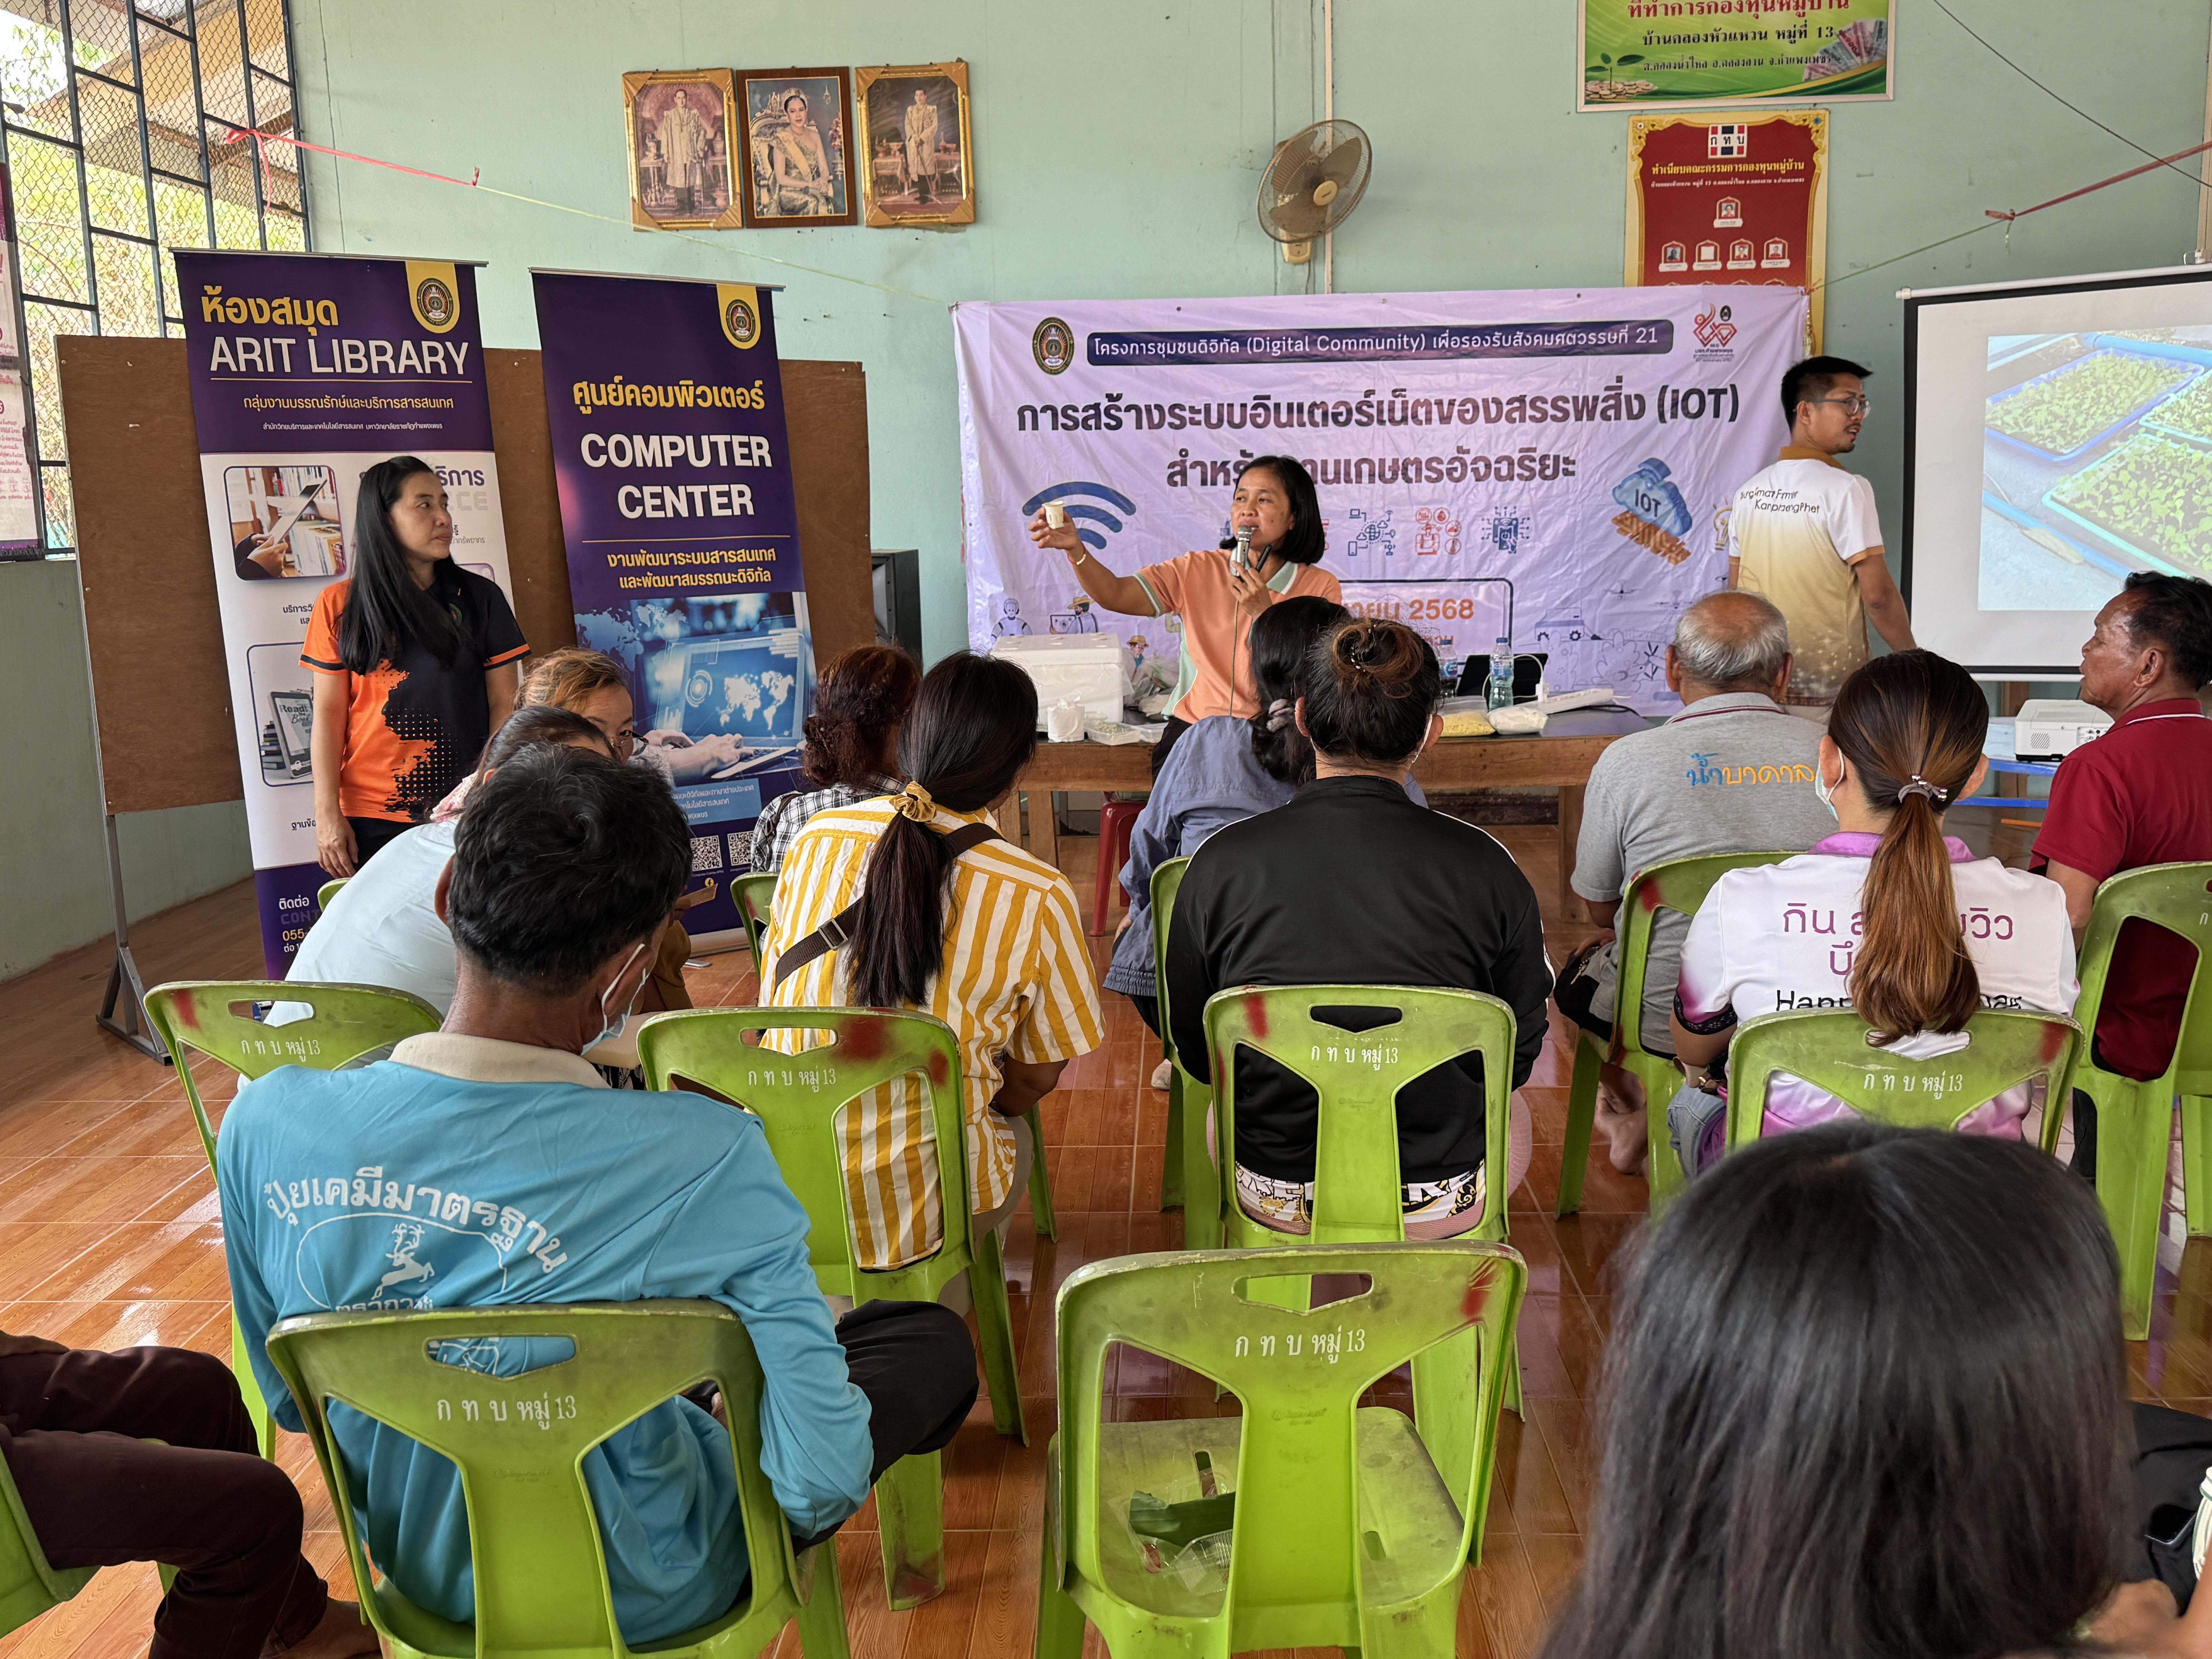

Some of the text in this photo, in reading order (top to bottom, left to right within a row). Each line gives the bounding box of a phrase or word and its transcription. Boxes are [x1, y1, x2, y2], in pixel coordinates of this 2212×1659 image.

[1643, 20, 1833, 46] บ้านคลองหัวแหวน หมู่ที่ 13
[1711, 135, 1745, 145] ก ท บ
[201, 285, 338, 336] ห้องสมุด
[210, 337, 469, 375] ARIT LIBRARY
[1094, 338, 1239, 359] โครงการชุมชนดิจิทัล
[1247, 336, 1310, 356] (Digital
[1317, 333, 1426, 353] Community)
[1636, 328, 1657, 344] 21
[244, 395, 453, 412] กลุ่มงานบรรณรักษ์และบริการสารสนเทศ
[573, 375, 765, 414] ศูนย์คอมพิวเตอร์
[1017, 376, 1739, 431] การสร้างระบบอินเตอร์เน็ตของสรรพสิ่ง (IOT)
[581, 433, 772, 467] COMPUTER
[435, 466, 484, 486] ริการ
[618, 484, 755, 519] CENTER
[1635, 489, 1661, 517] IOT
[607, 548, 776, 567] งานพัฒนาระบบสารสนเทศ
[620, 567, 771, 589] และพัฒนาสมรรถนะดิจิทัล
[1409, 599, 1474, 620] 2568
[1686, 753, 1815, 786] น้ำบาดาล
[279, 895, 309, 910] ติดต่อ
[281, 909, 321, 925] CONT
[1783, 903, 1836, 934] กิน
[1960, 908, 2013, 940] วิว
[284, 943, 294, 952] ต่อ
[242, 1037, 321, 1062] ก ท บ หมู่ 13
[1311, 1043, 1398, 1071] ก ท บ หมู่ 13
[749, 1065, 836, 1093] ก ท บ หมู่ 13
[1863, 1070, 1962, 1100] ก ท บ หมู่ 13
[264, 1166, 570, 1274] ปุ๋ยเคมีมาตรฐาน
[1235, 1326, 1365, 1364] ก ท บ หมู่ 13
[437, 1392, 576, 1429] ก ท บ หมู่ 13
